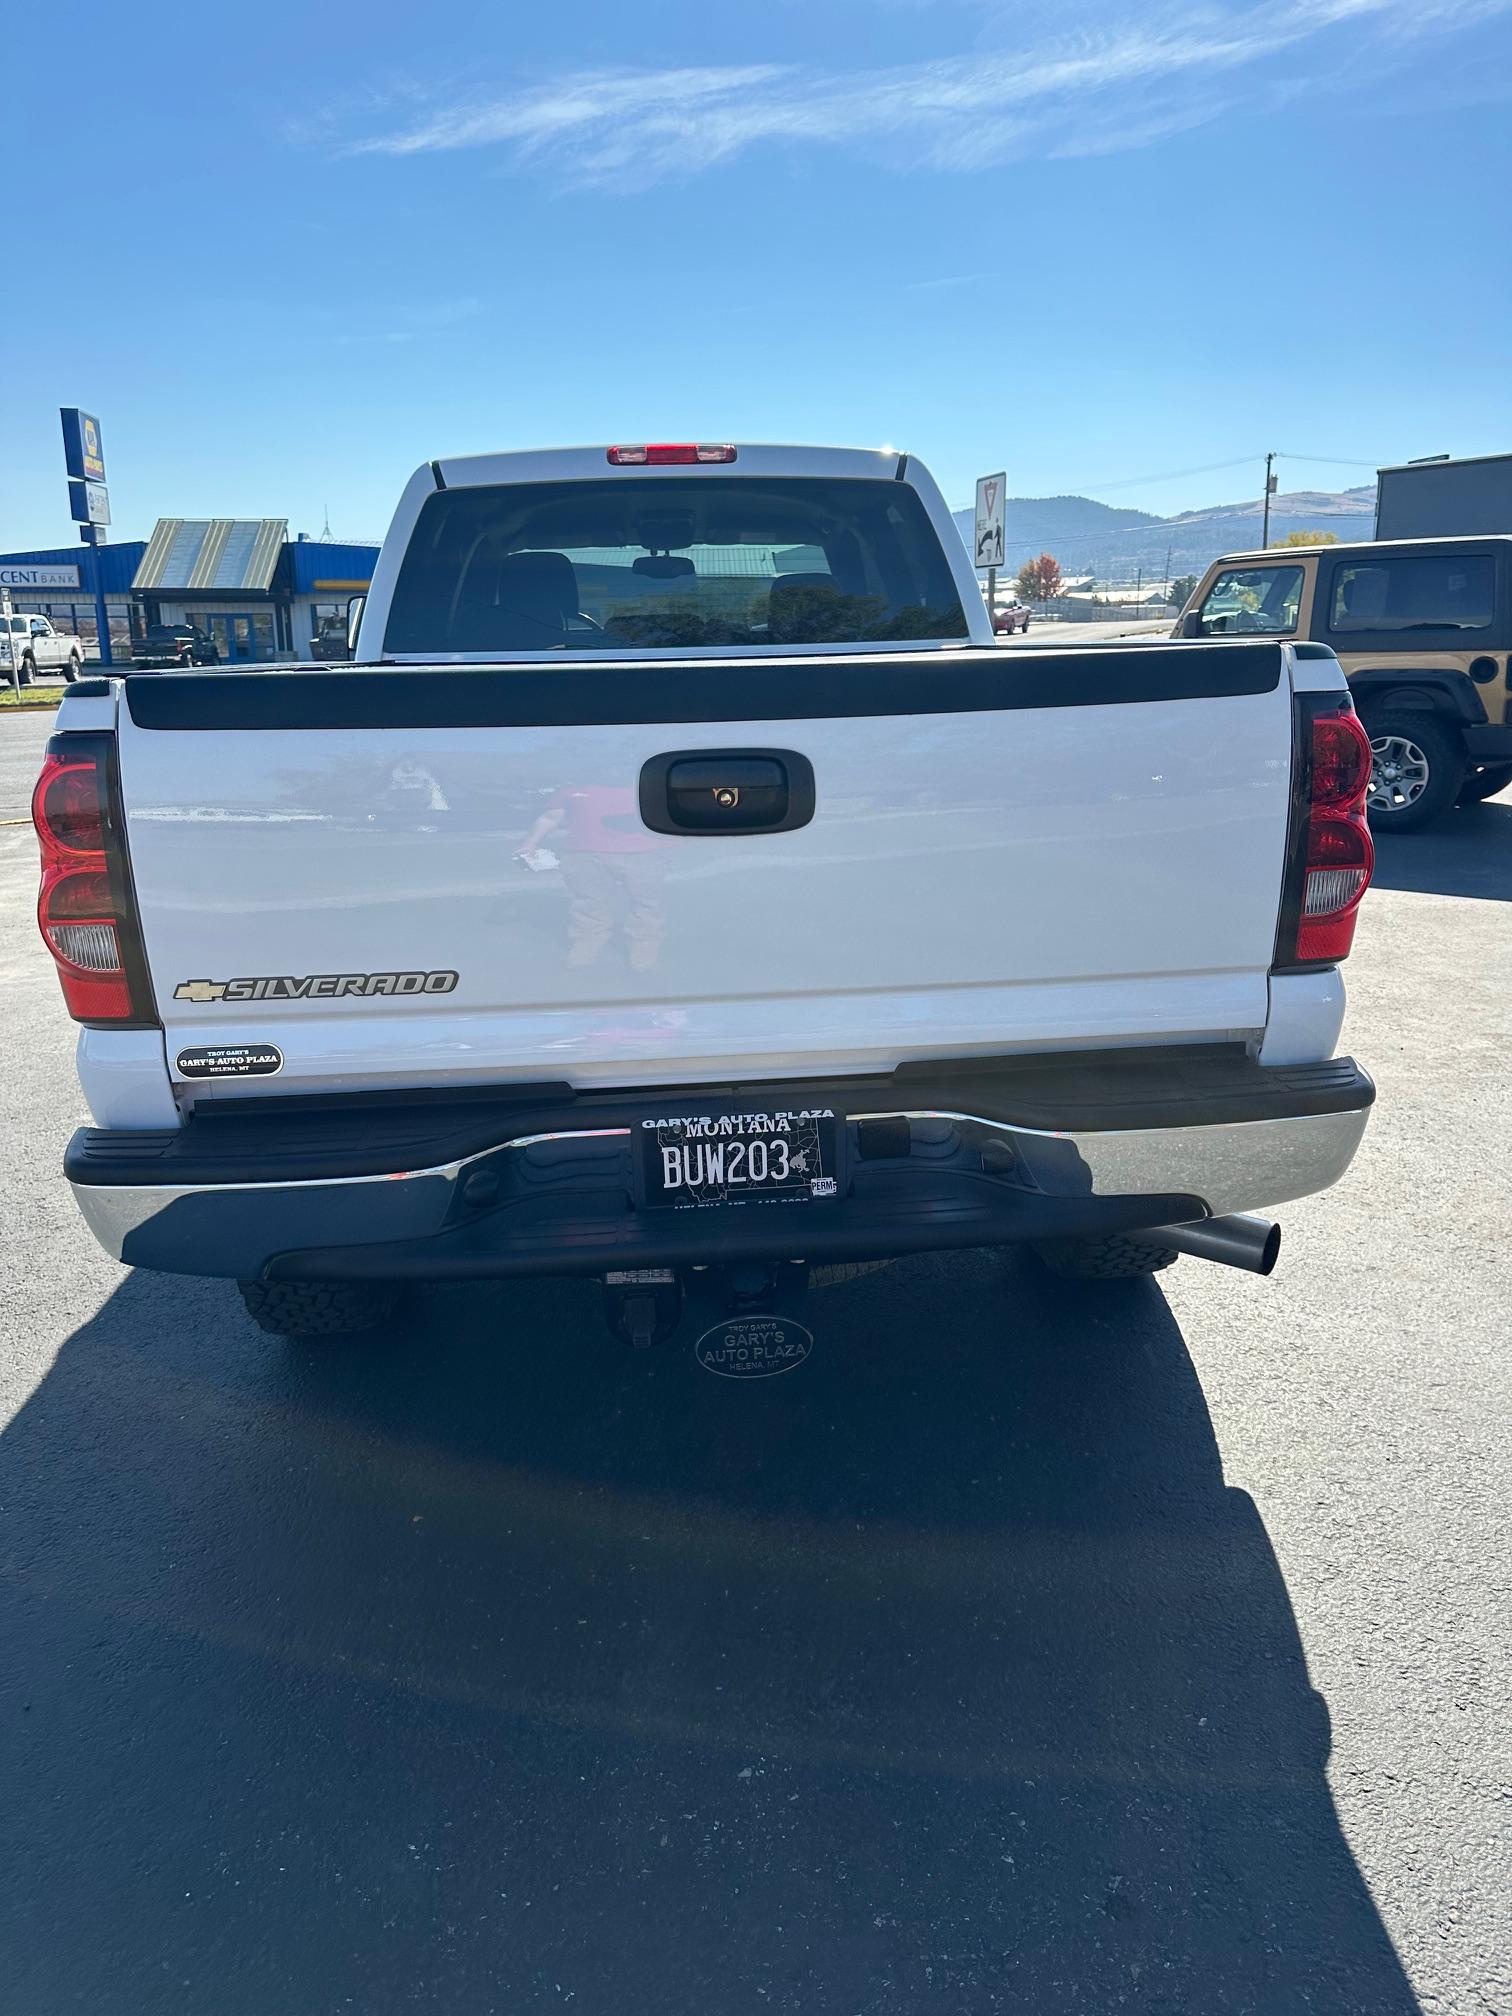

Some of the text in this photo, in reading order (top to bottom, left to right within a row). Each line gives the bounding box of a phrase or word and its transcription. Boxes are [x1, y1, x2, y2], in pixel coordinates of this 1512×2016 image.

[0, 570, 75, 584] CENT BANK
[224, 971, 457, 999] SILVERADO
[180, 1055, 278, 1067] GARY'S AUTO PLAZA
[642, 1109, 835, 1129] GARY'S AUTO PLAZA
[685, 1119, 792, 1138] MONTANA
[661, 1140, 790, 1189] BUW203
[724, 1331, 785, 1347] GARY'S
[703, 1343, 807, 1363] AUTO PLAZA
